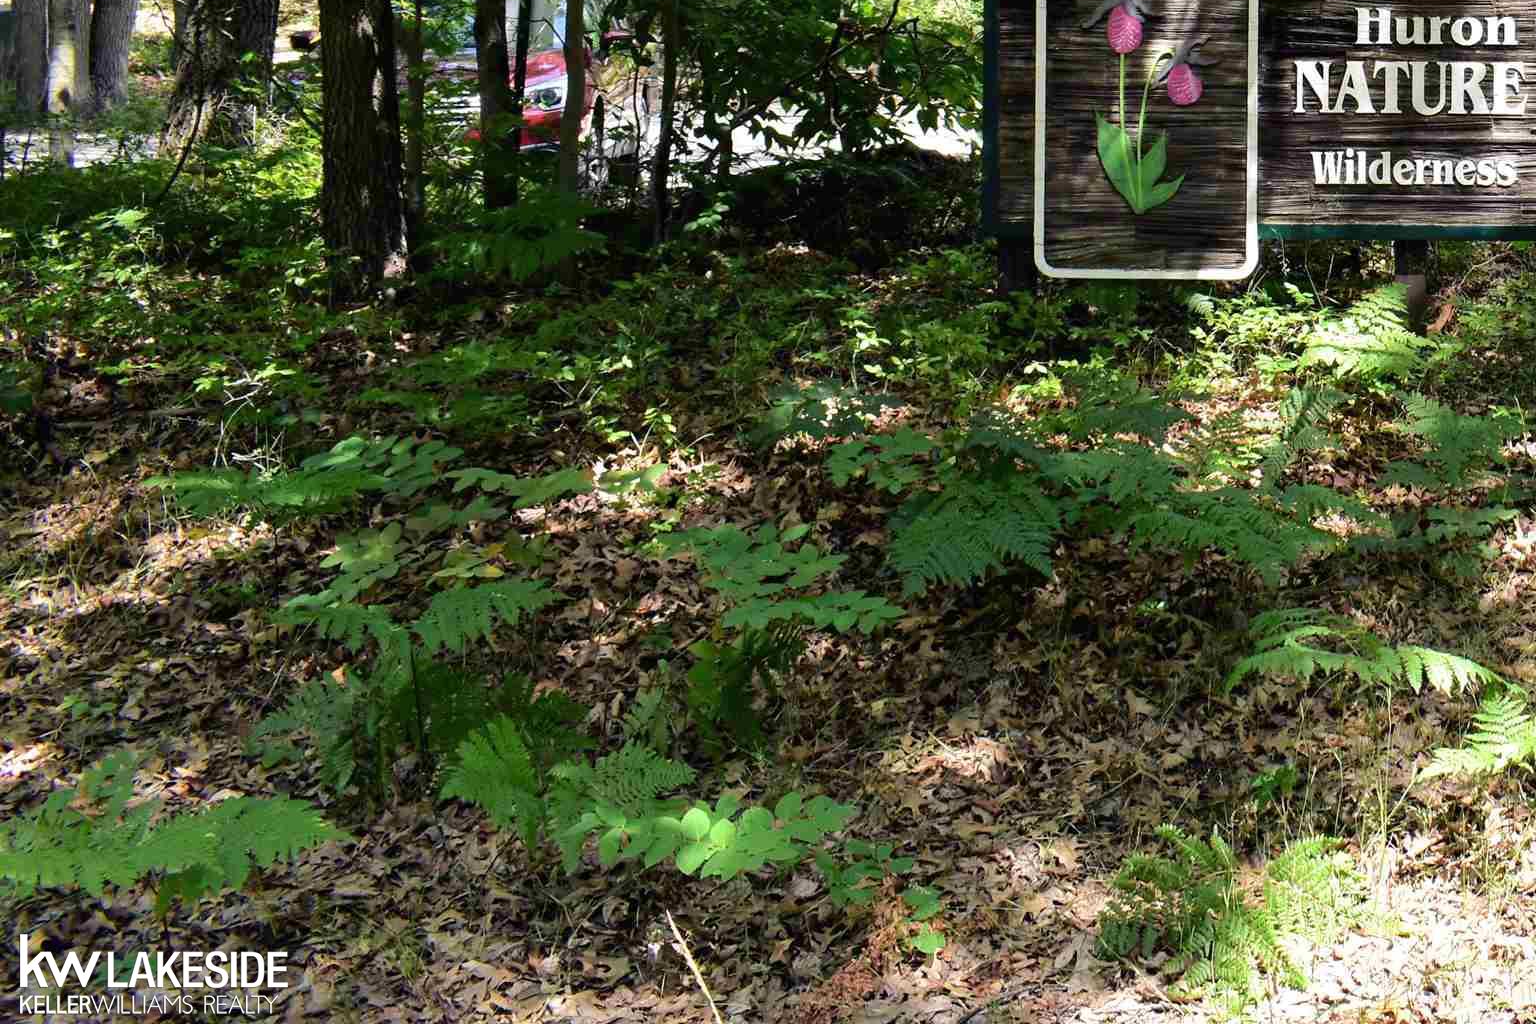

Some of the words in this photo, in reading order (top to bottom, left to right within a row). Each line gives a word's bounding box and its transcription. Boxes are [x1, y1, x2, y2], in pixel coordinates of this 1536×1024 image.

[1355, 7, 1518, 46] Huron
[1292, 60, 1528, 116] NATURE
[1311, 151, 1519, 187] Wilderness
